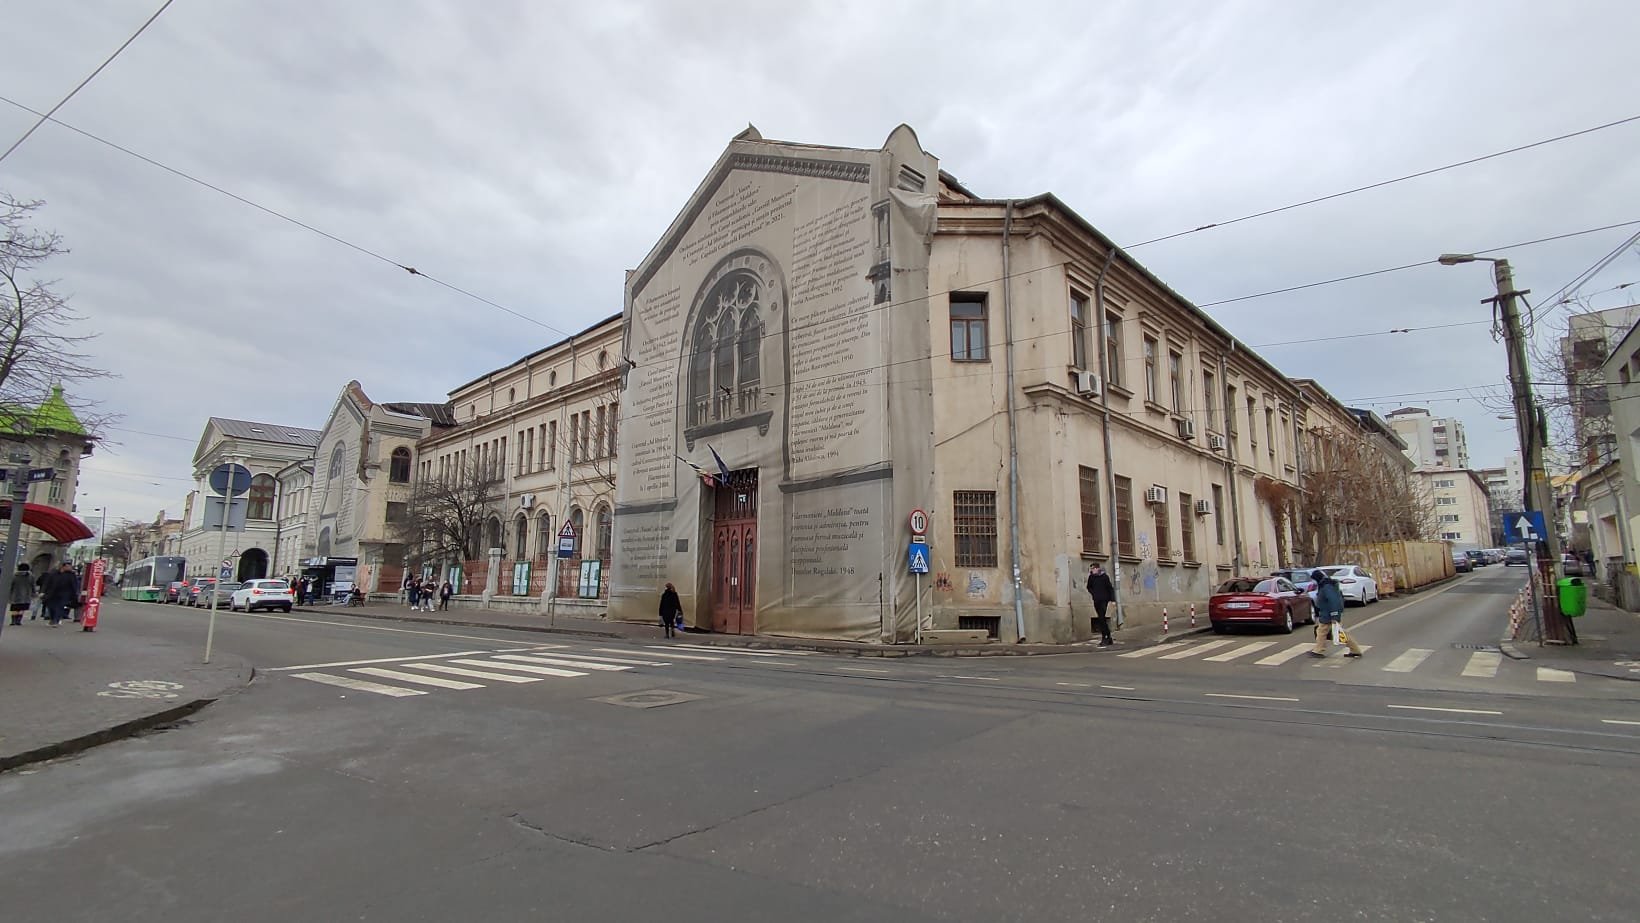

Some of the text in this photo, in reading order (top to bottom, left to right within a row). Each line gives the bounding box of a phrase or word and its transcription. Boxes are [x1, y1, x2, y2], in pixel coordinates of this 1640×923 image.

[712, 202, 737, 218] Filarmonica
[737, 186, 760, 205] „Moldova”
[770, 198, 792, 216] proiectul
[718, 221, 731, 232] Corul
[849, 520, 869, 530] pentru
[914, 516, 924, 529] 10
[839, 567, 855, 576] 1948
